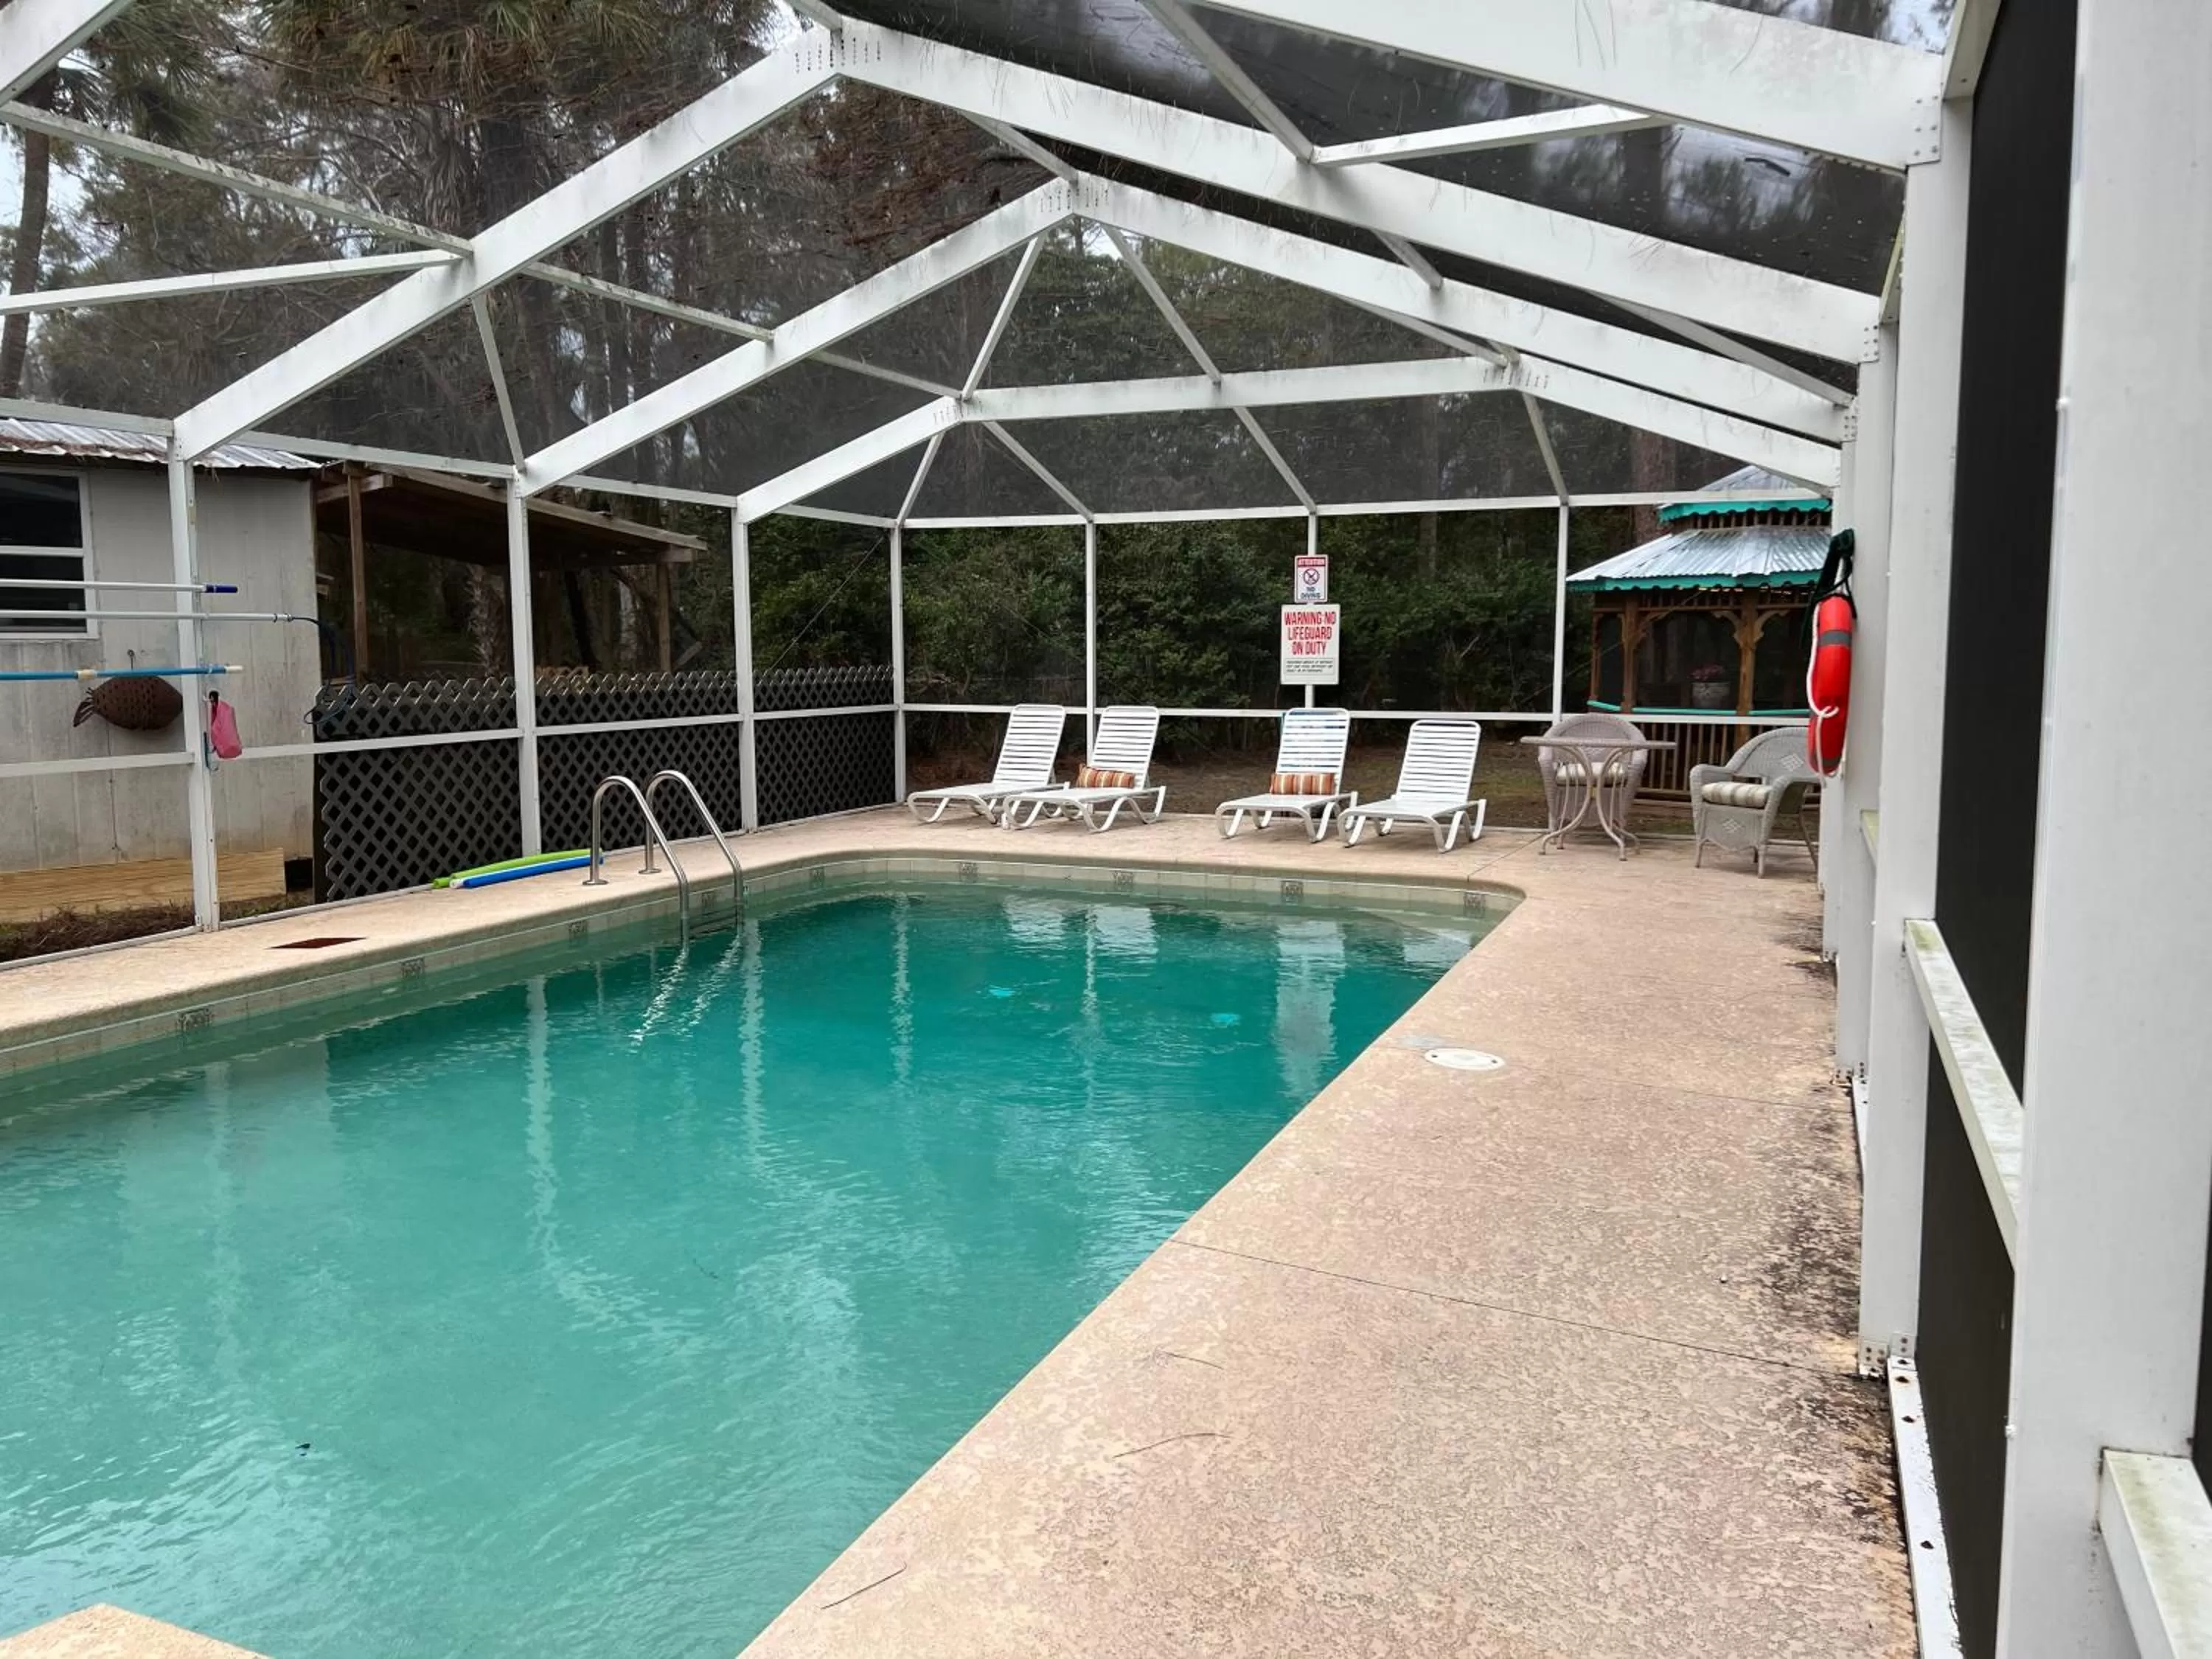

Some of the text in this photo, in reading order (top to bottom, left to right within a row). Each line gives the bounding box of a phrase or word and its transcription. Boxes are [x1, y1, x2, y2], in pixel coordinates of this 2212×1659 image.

[1284, 611, 1336, 625] WARNING NO
[1288, 626, 1332, 640] LIFEGUARD
[1292, 641, 1326, 655] ON DUTY
